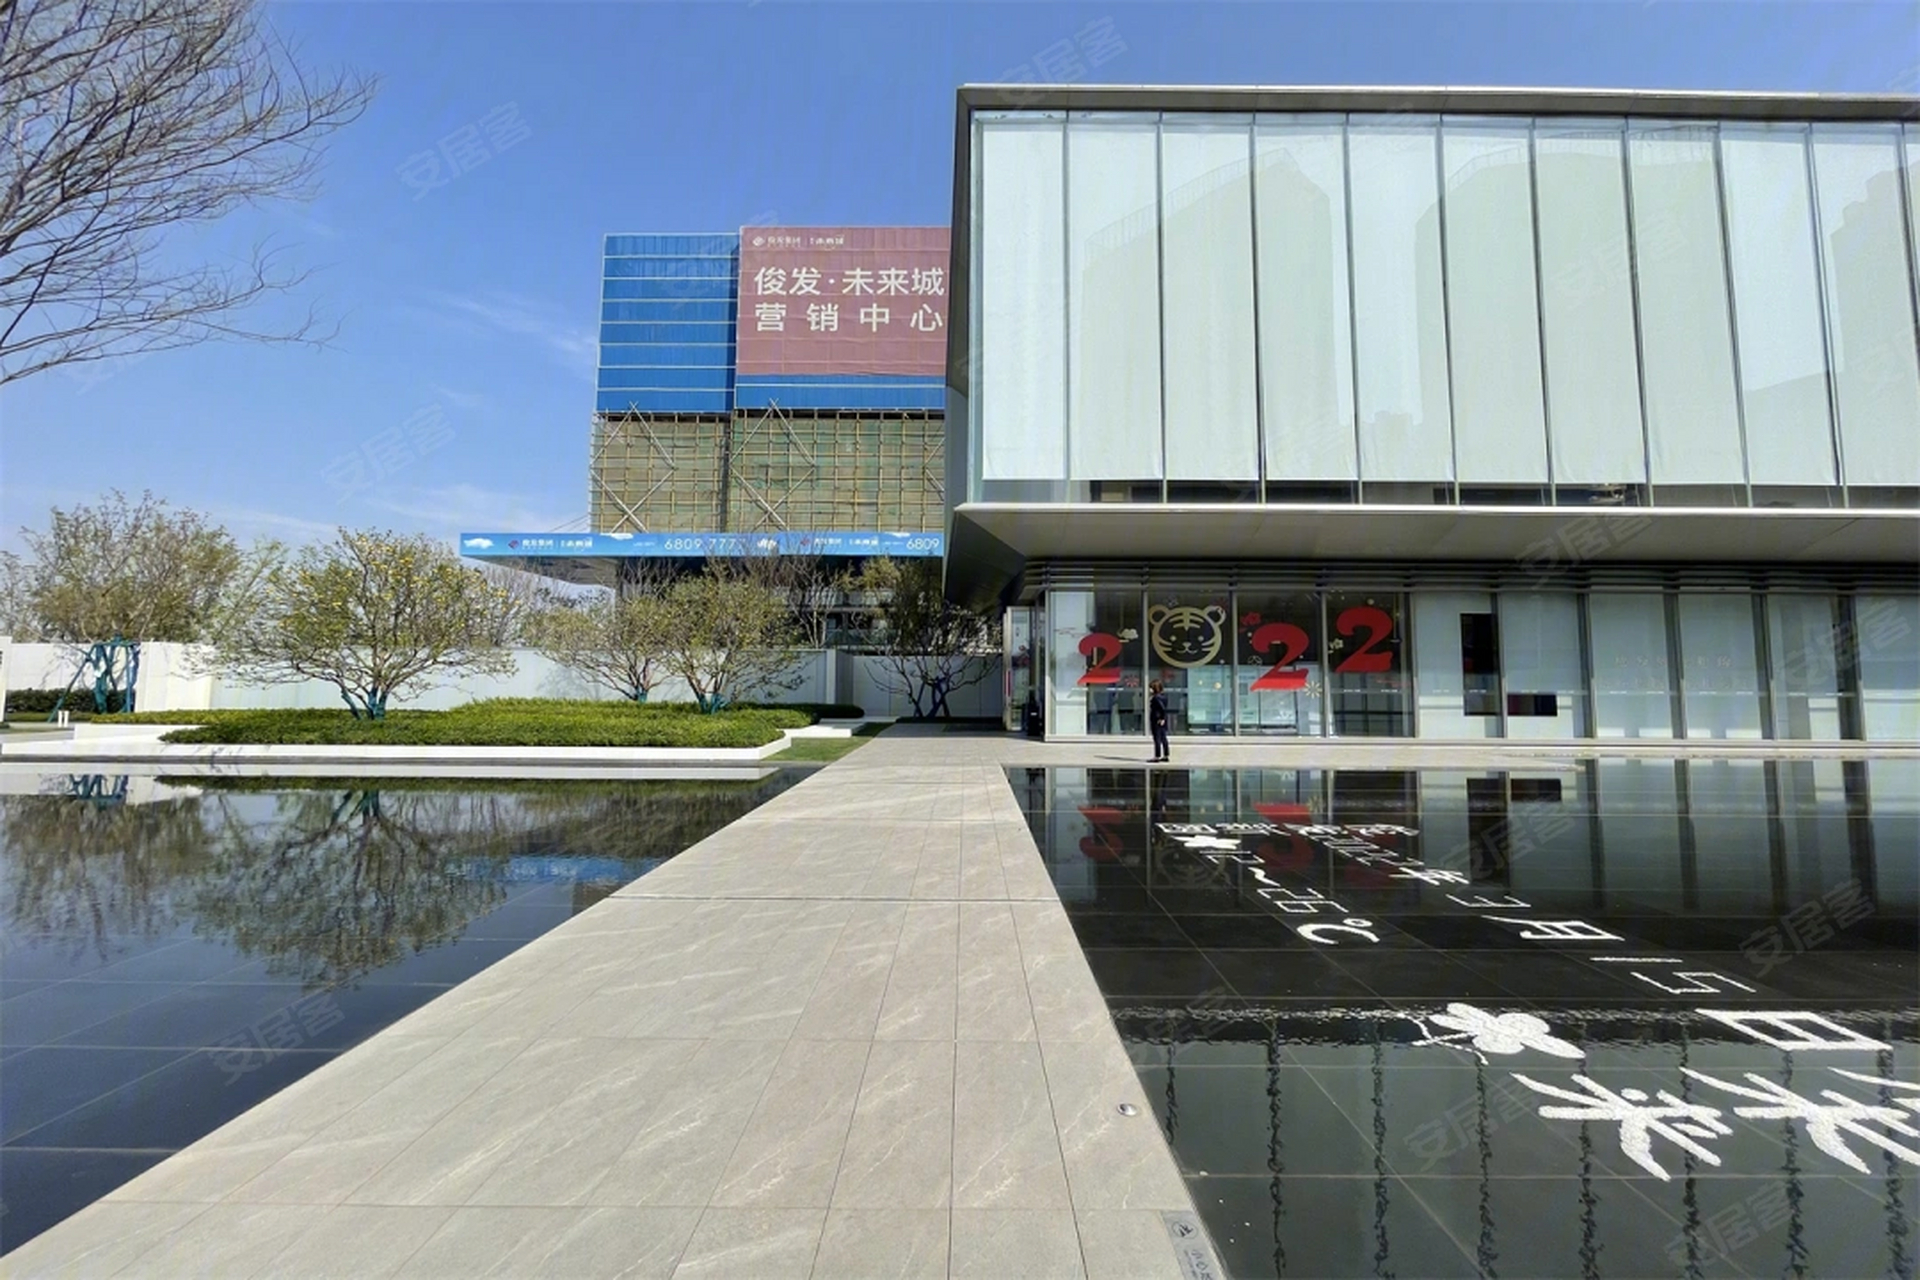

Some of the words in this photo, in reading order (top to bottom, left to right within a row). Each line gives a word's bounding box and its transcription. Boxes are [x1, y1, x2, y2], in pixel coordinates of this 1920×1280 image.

[753, 266, 945, 296] 俊发·未来城
[754, 303, 943, 332] 营销中心
[664, 538, 702, 550] 6809
[906, 537, 940, 549] 6809
[1335, 606, 1393, 672] 2
[1509, 1066, 1920, 1182] 未来
